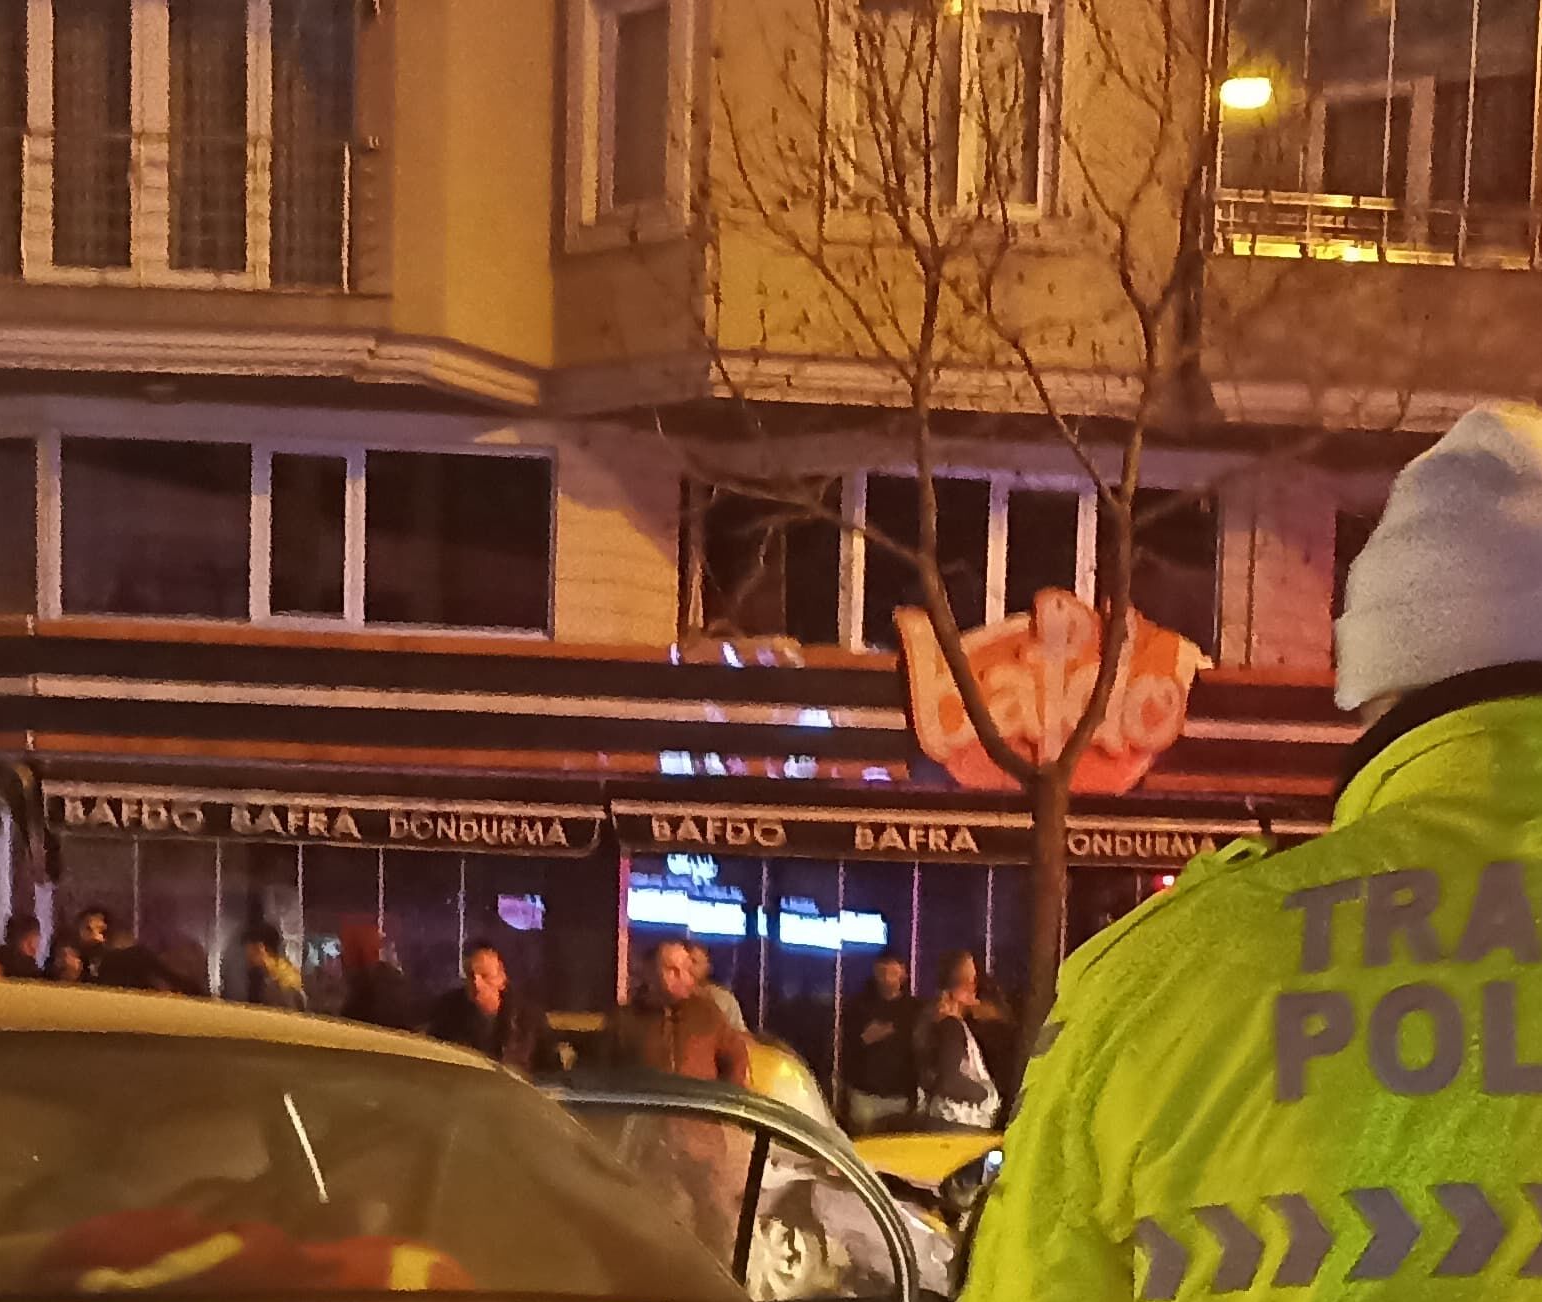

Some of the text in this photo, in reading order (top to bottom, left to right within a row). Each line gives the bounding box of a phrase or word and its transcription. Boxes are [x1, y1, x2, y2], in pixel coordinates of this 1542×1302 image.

[63, 796, 569, 848] BAFDO BAFRA DONDURMA
[650, 814, 1217, 857] BAFDO BAFRA ONDURMA
